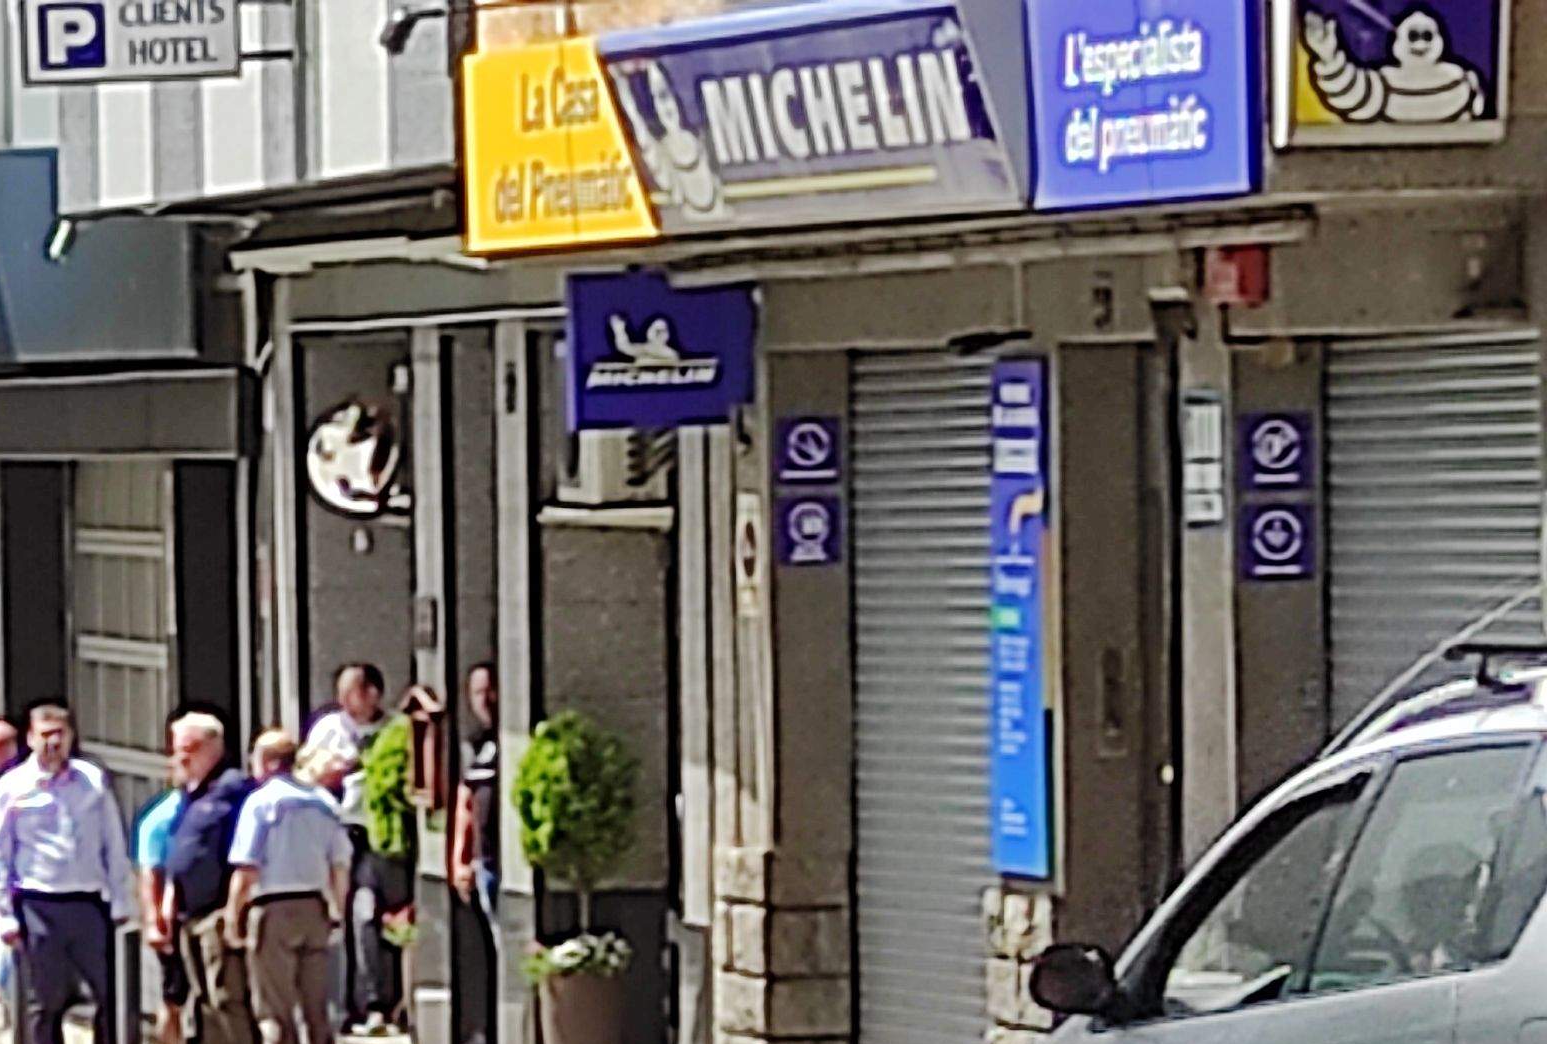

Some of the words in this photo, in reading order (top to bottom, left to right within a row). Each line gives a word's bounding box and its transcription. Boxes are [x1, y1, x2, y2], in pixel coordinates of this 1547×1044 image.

[118, 0, 225, 27] CLIENTS
[128, 37, 218, 66] HOTEL
[1064, 20, 1202, 95] L'especialista
[521, 72, 545, 132] La
[550, 67, 599, 128] Casa
[700, 48, 973, 165] MICHELIN
[1066, 106, 1098, 164] del
[495, 163, 526, 224] del
[585, 366, 719, 390] MICHELIN
